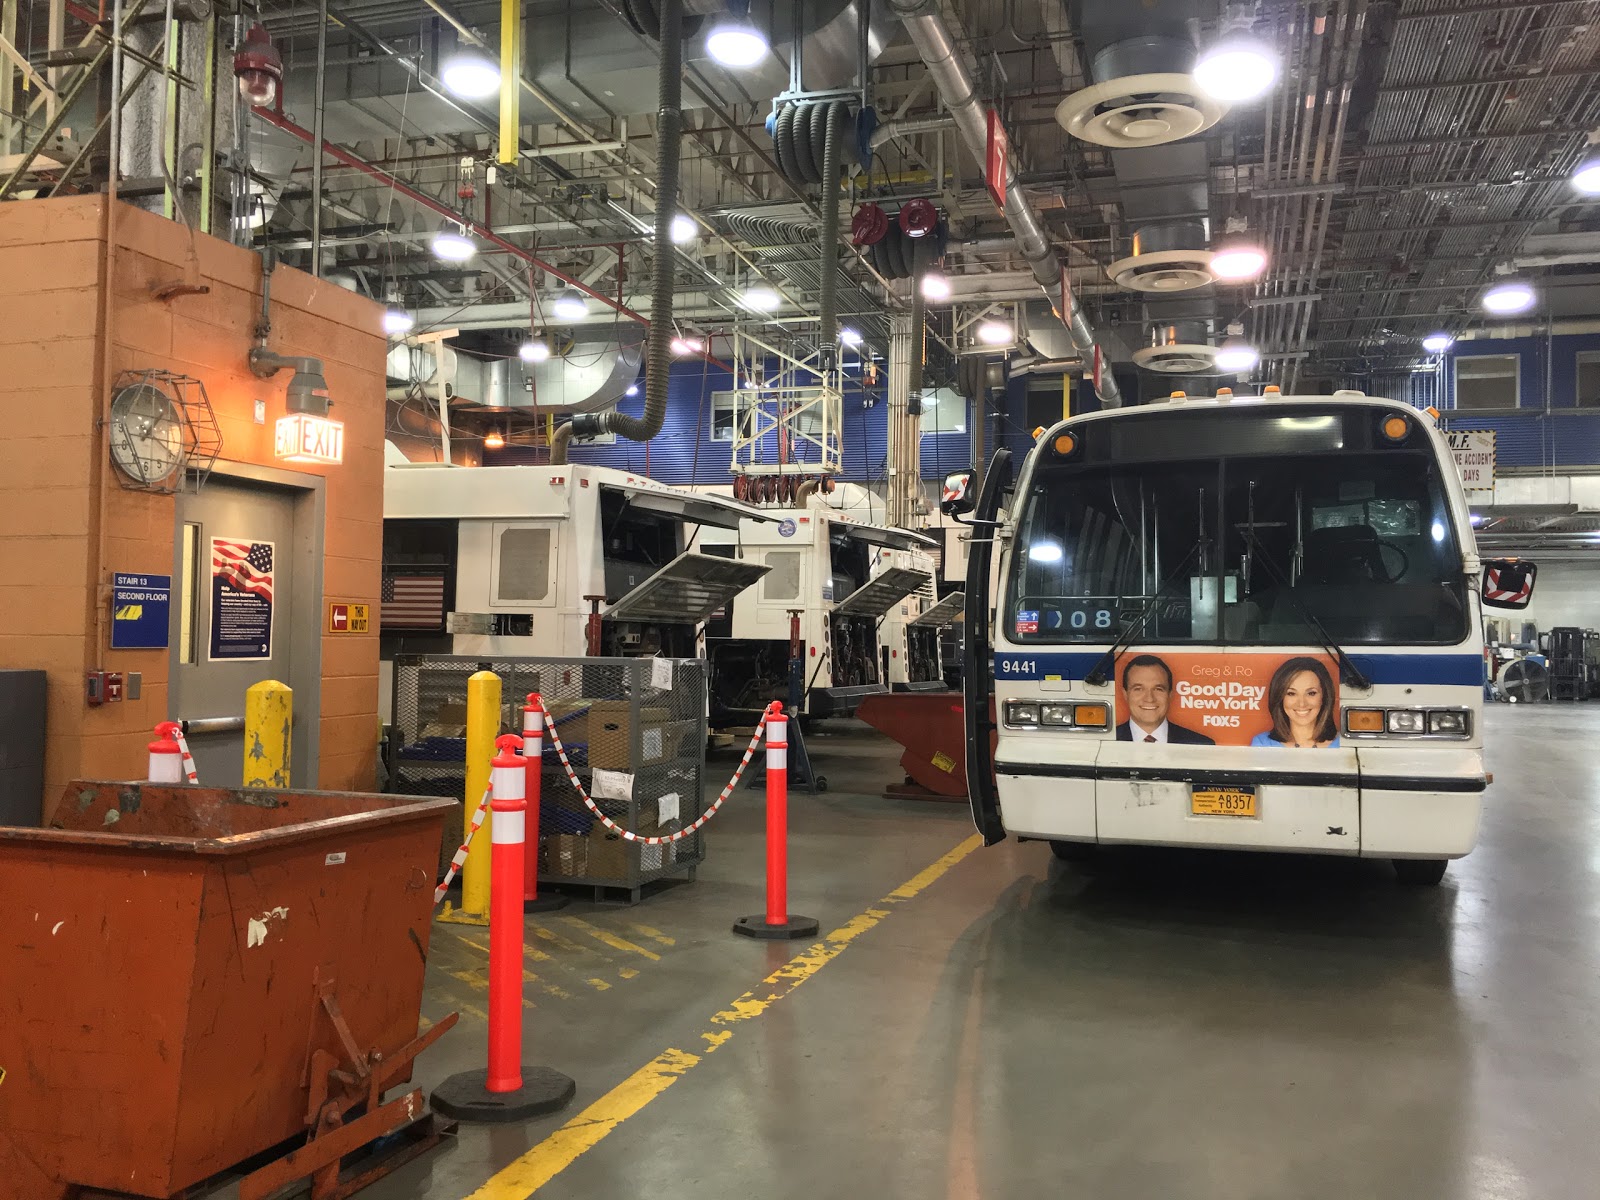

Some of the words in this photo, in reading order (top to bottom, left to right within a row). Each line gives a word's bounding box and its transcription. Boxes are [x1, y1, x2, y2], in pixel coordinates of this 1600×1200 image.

[302, 420, 341, 459] EXIT
[1465, 453, 1491, 465] ACCIDENT
[143, 461, 149, 472] 6
[1464, 469, 1479, 481] DAYS
[117, 576, 138, 584] STAIR
[140, 578, 148, 586] 13
[117, 592, 145, 600] SECOND
[145, 593, 167, 601] FLOOR
[354, 605, 364, 618] THIS
[351, 618, 359, 631] WAY
[359, 619, 367, 631] OUT
[1002, 660, 1037, 674] 9441
[1191, 665, 1221, 678] Greg
[1222, 665, 1232, 676] &
[1235, 666, 1253, 677] Ro
[1176, 681, 1227, 697] Good
[1228, 682, 1266, 701] Day
[1180, 696, 1220, 710] New
[1219, 696, 1261, 711] York
